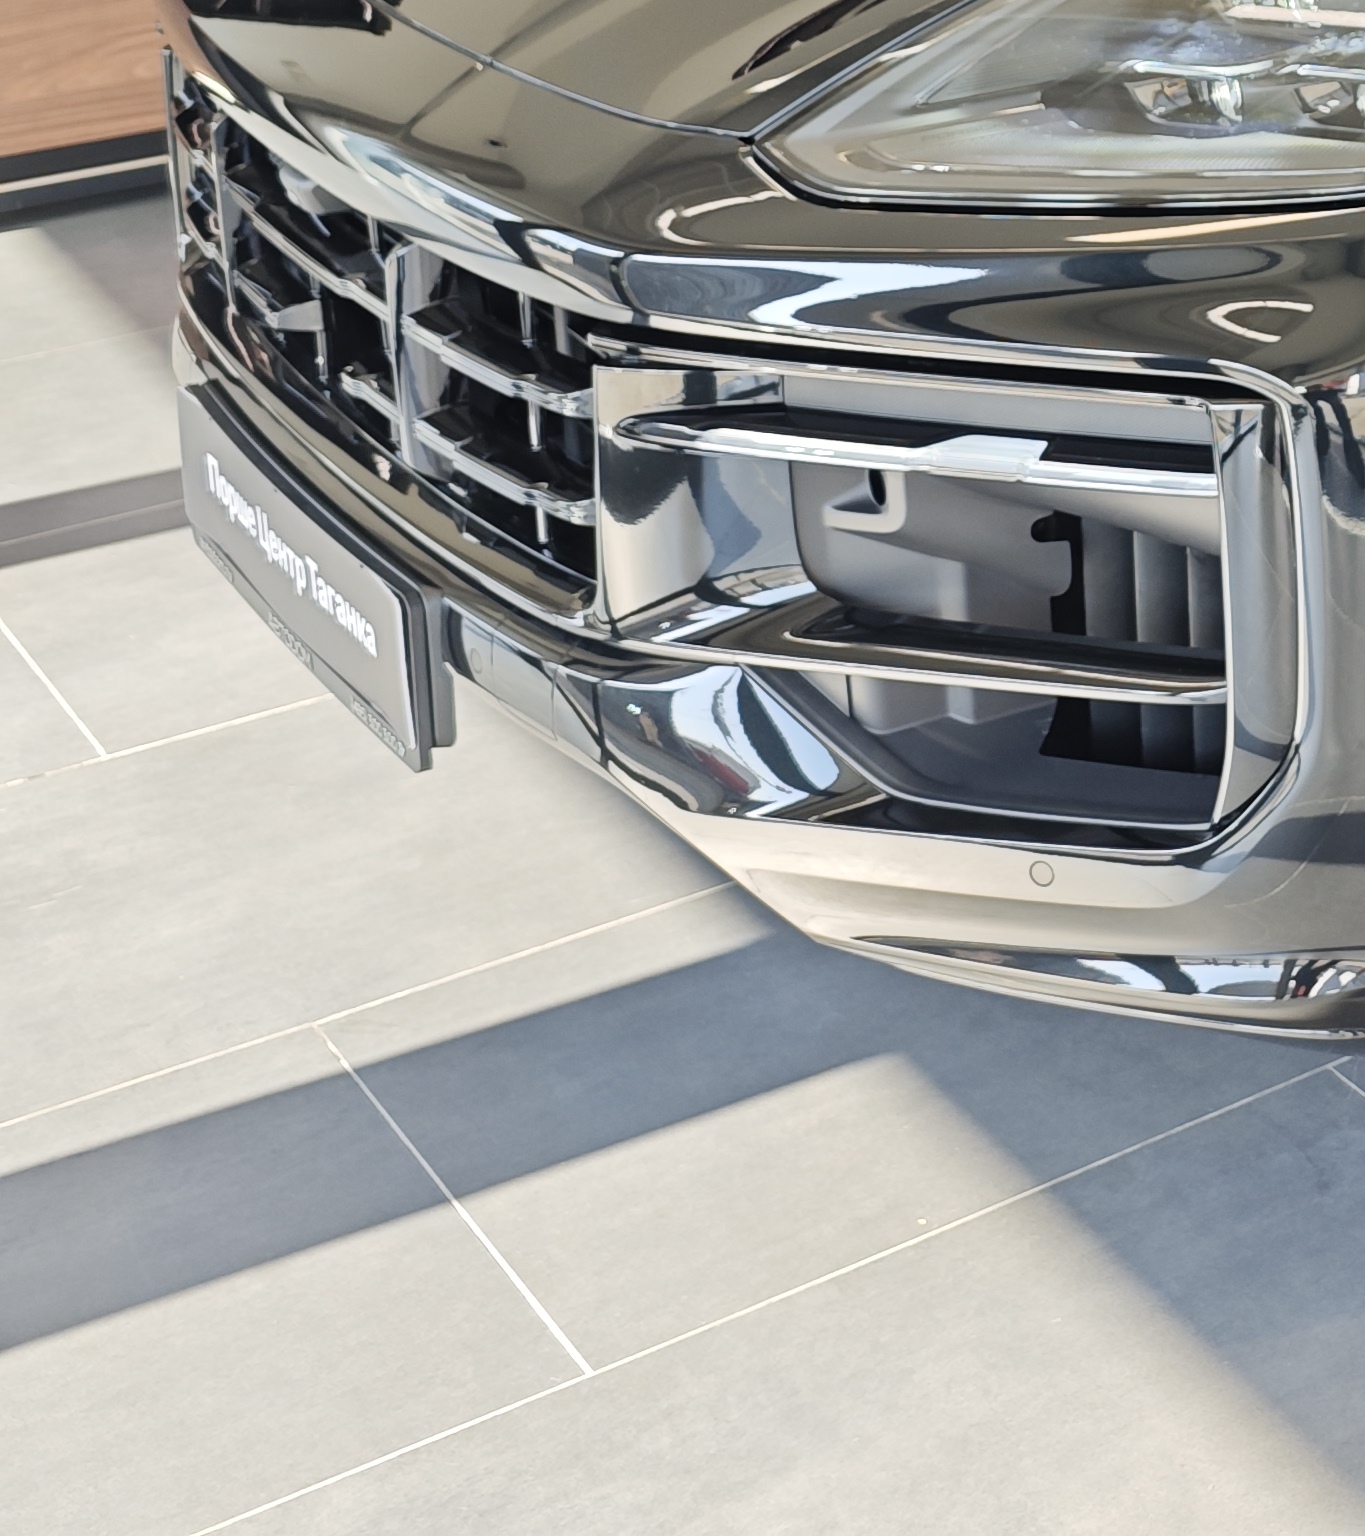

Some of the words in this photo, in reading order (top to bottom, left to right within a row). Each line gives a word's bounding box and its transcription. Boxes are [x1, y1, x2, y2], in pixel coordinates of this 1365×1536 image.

[205, 451, 258, 539] Порше
[255, 505, 307, 597] Центр
[304, 555, 378, 658] Таганка
